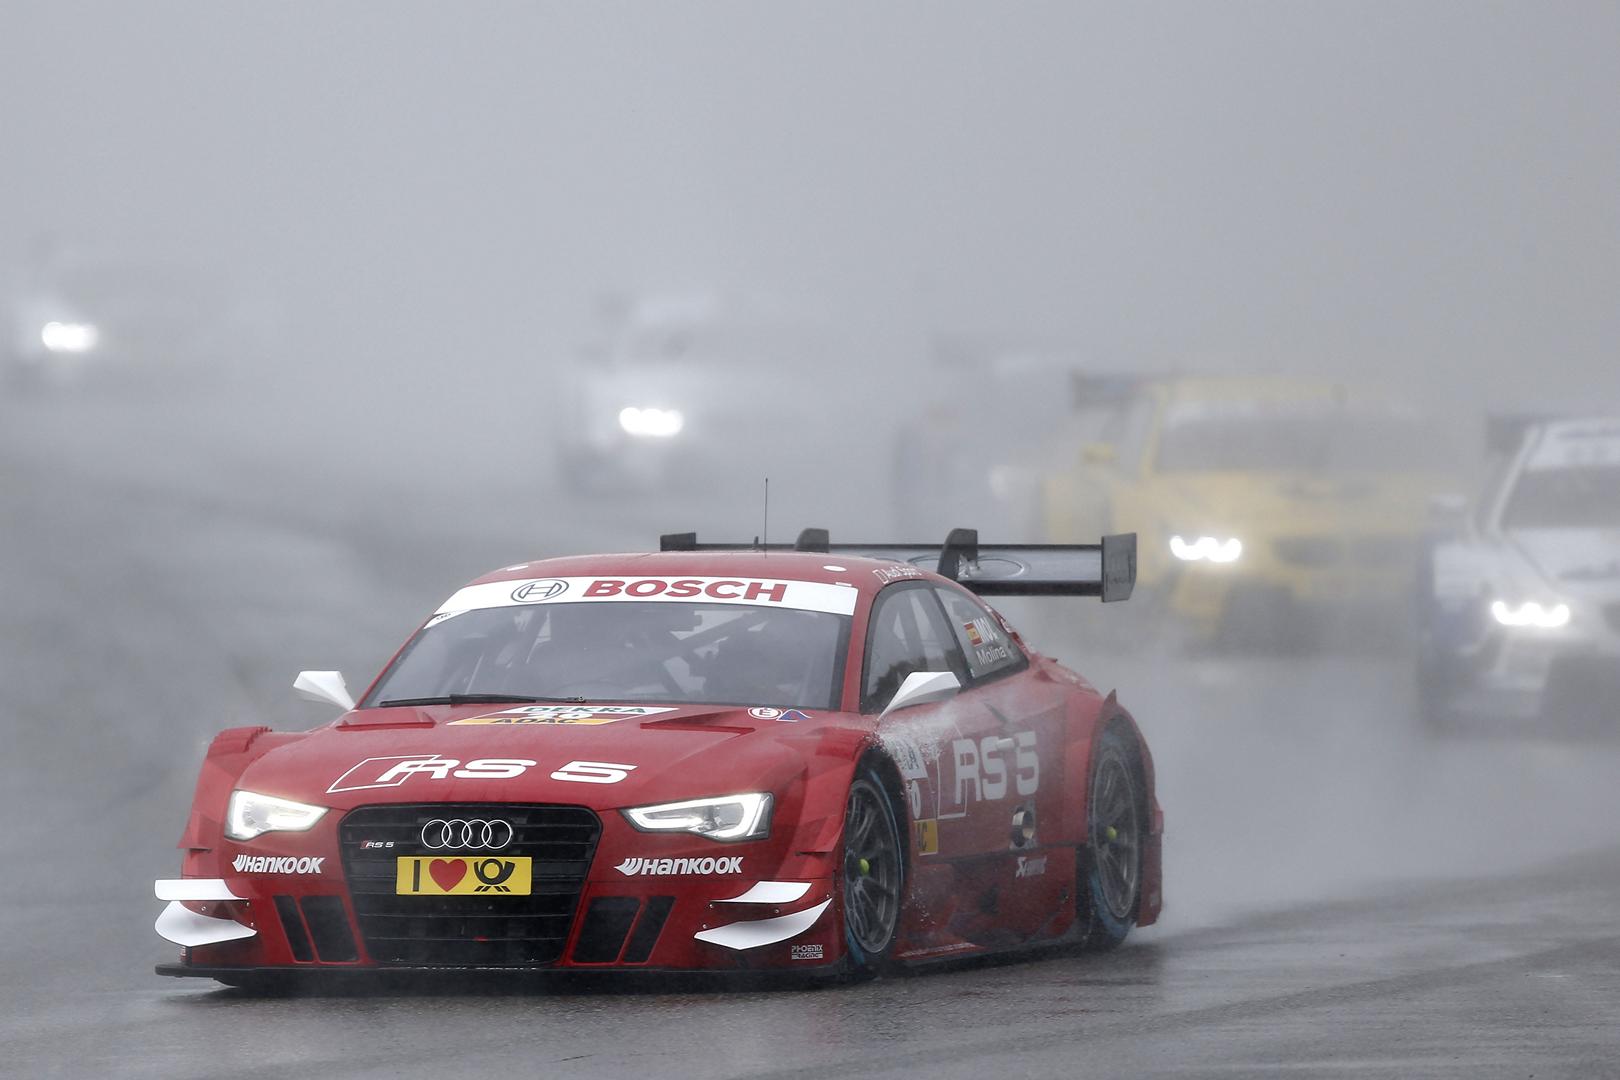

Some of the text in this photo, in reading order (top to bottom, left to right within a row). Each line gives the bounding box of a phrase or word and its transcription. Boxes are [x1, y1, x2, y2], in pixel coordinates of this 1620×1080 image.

[582, 579, 788, 602] BOSCH
[976, 646, 1006, 665] Molina
[375, 759, 638, 784] RS 5
[952, 736, 1007, 804] RS
[1013, 731, 1039, 796] 5
[412, 859, 421, 892] I
